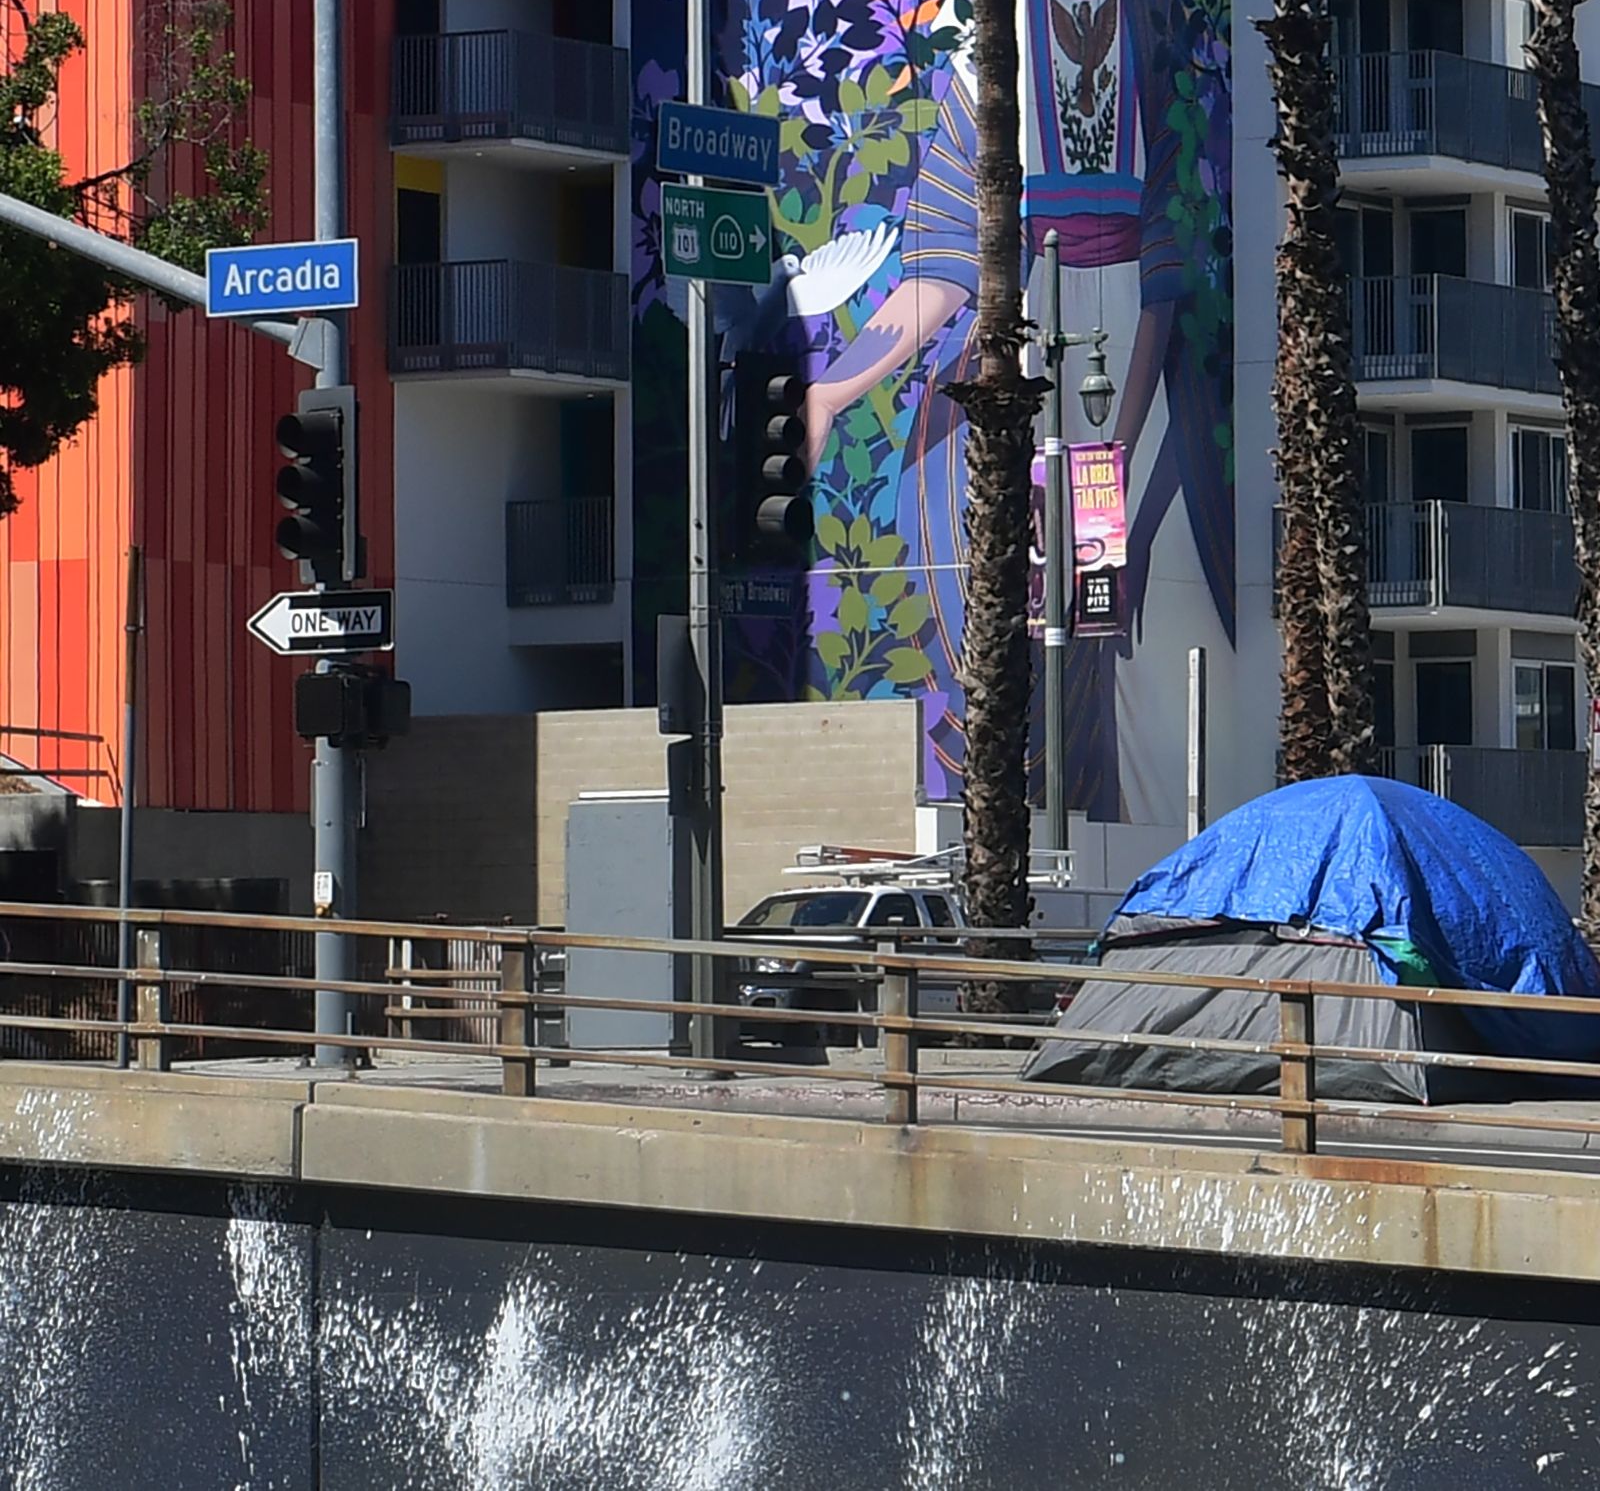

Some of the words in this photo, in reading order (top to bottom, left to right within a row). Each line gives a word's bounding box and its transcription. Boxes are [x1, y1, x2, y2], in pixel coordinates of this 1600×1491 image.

[668, 117, 772, 172] Broadway
[665, 197, 705, 218] NORTH
[677, 234, 696, 254] 101
[719, 232, 738, 251] 110
[223, 258, 340, 297] Arcadia
[1076, 465, 1089, 486] LA
[1074, 488, 1095, 509] TAR
[1095, 486, 1118, 509] PITS
[1087, 584, 1109, 595] TAR
[1087, 596, 1110, 606] PITS
[291, 611, 330, 634] ONE
[337, 609, 376, 632] WAY
